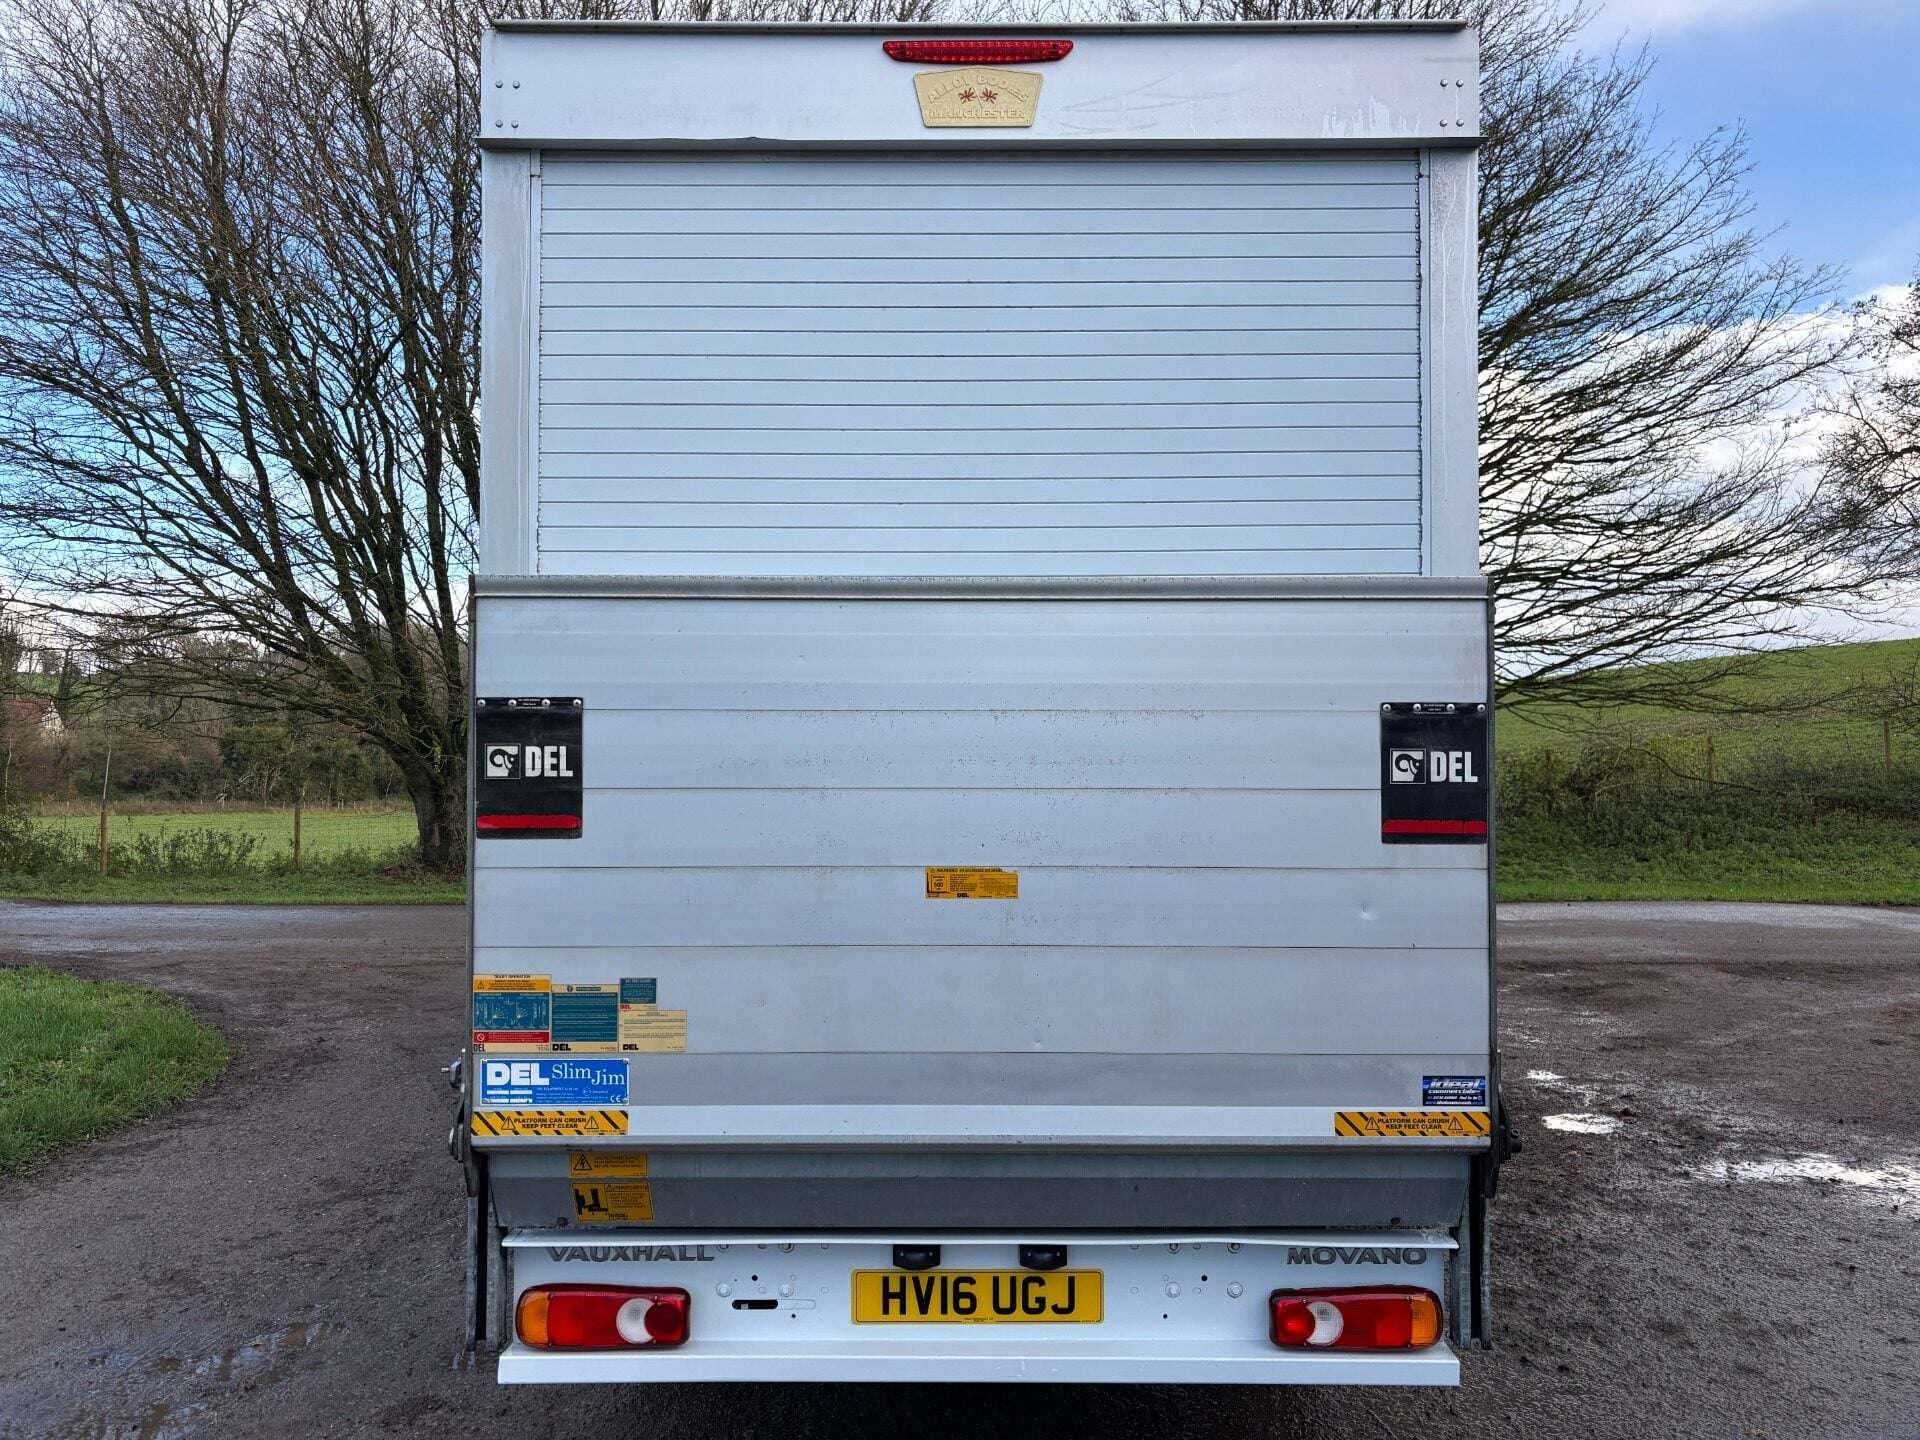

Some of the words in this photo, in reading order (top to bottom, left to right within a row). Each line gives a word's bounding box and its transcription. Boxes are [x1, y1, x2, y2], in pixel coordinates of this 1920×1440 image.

[525, 745, 574, 777] DEL
[1430, 751, 1478, 783] DEL
[552, 1043, 572, 1051] DEL
[622, 1043, 639, 1051] DEL
[486, 1062, 550, 1086] DEL
[552, 1062, 591, 1080] Slim
[591, 1069, 625, 1086] Jim
[546, 1245, 715, 1262] VAUXHALL
[1287, 1247, 1427, 1265] MOVANO
[882, 1276, 977, 1315] HV16
[992, 1276, 1075, 1315] UGJ
